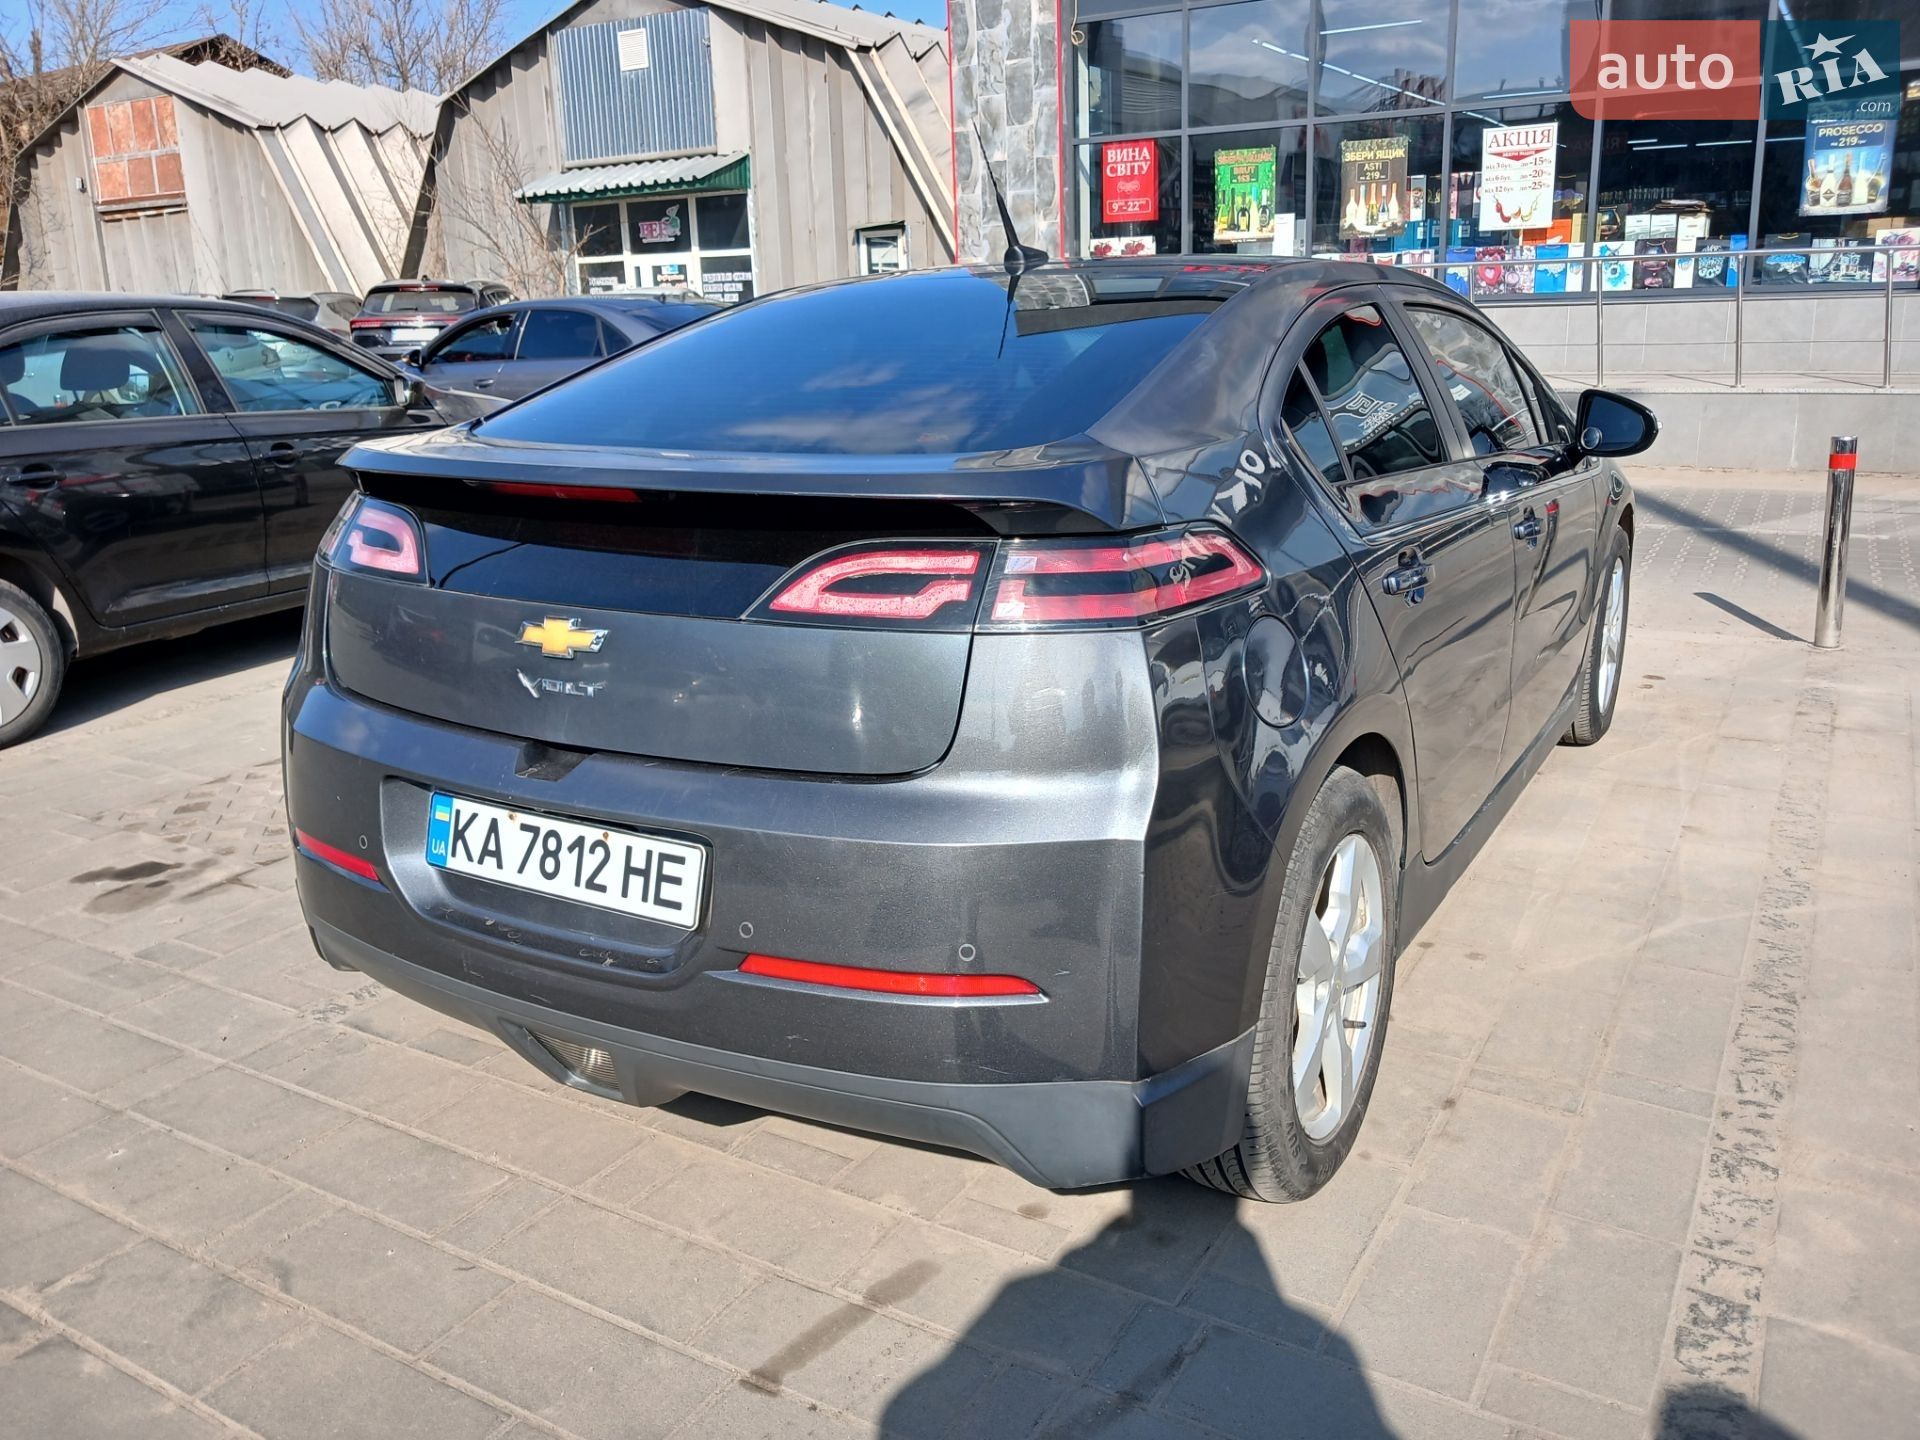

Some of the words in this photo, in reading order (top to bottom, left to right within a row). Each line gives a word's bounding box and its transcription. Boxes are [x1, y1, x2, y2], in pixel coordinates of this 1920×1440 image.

[1818, 124, 1883, 137] PROSECCO
[1488, 128, 1552, 148] АКЦІЯ
[1838, 137, 1858, 147] 219
[1107, 146, 1151, 162] ВИНА
[1344, 151, 1374, 161] ЗБЕРИ
[1375, 148, 1405, 160] ЯЩИК
[1106, 161, 1151, 177] СВІТУ
[1233, 166, 1255, 174] BRUT
[1363, 162, 1382, 171] ASTI
[1365, 171, 1380, 180] 219
[516, 668, 603, 698] VOLT
[431, 841, 446, 857] UA
[450, 808, 503, 870] KA
[516, 822, 611, 894] 7812
[621, 845, 686, 911] HE
